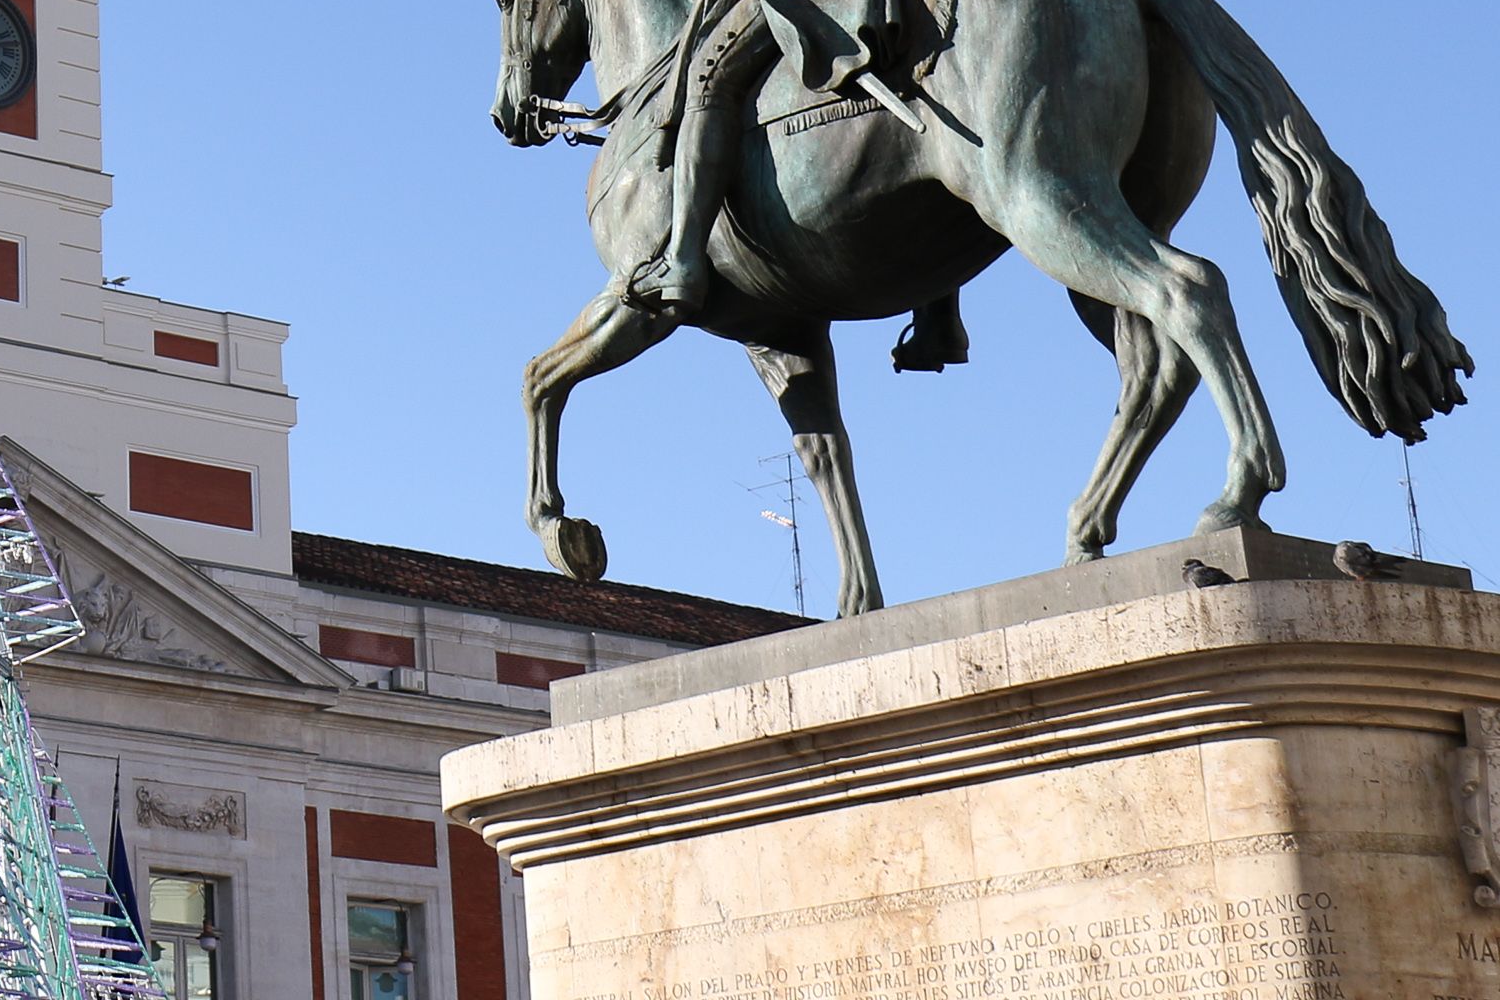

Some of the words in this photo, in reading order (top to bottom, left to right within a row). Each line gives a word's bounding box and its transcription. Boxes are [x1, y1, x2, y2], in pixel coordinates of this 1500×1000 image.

[1280, 914, 1336, 936] REAL
[644, 981, 692, 1000] SALON
[1226, 891, 1338, 921] BOTANICO.
[1275, 959, 1341, 981] SIERRA
